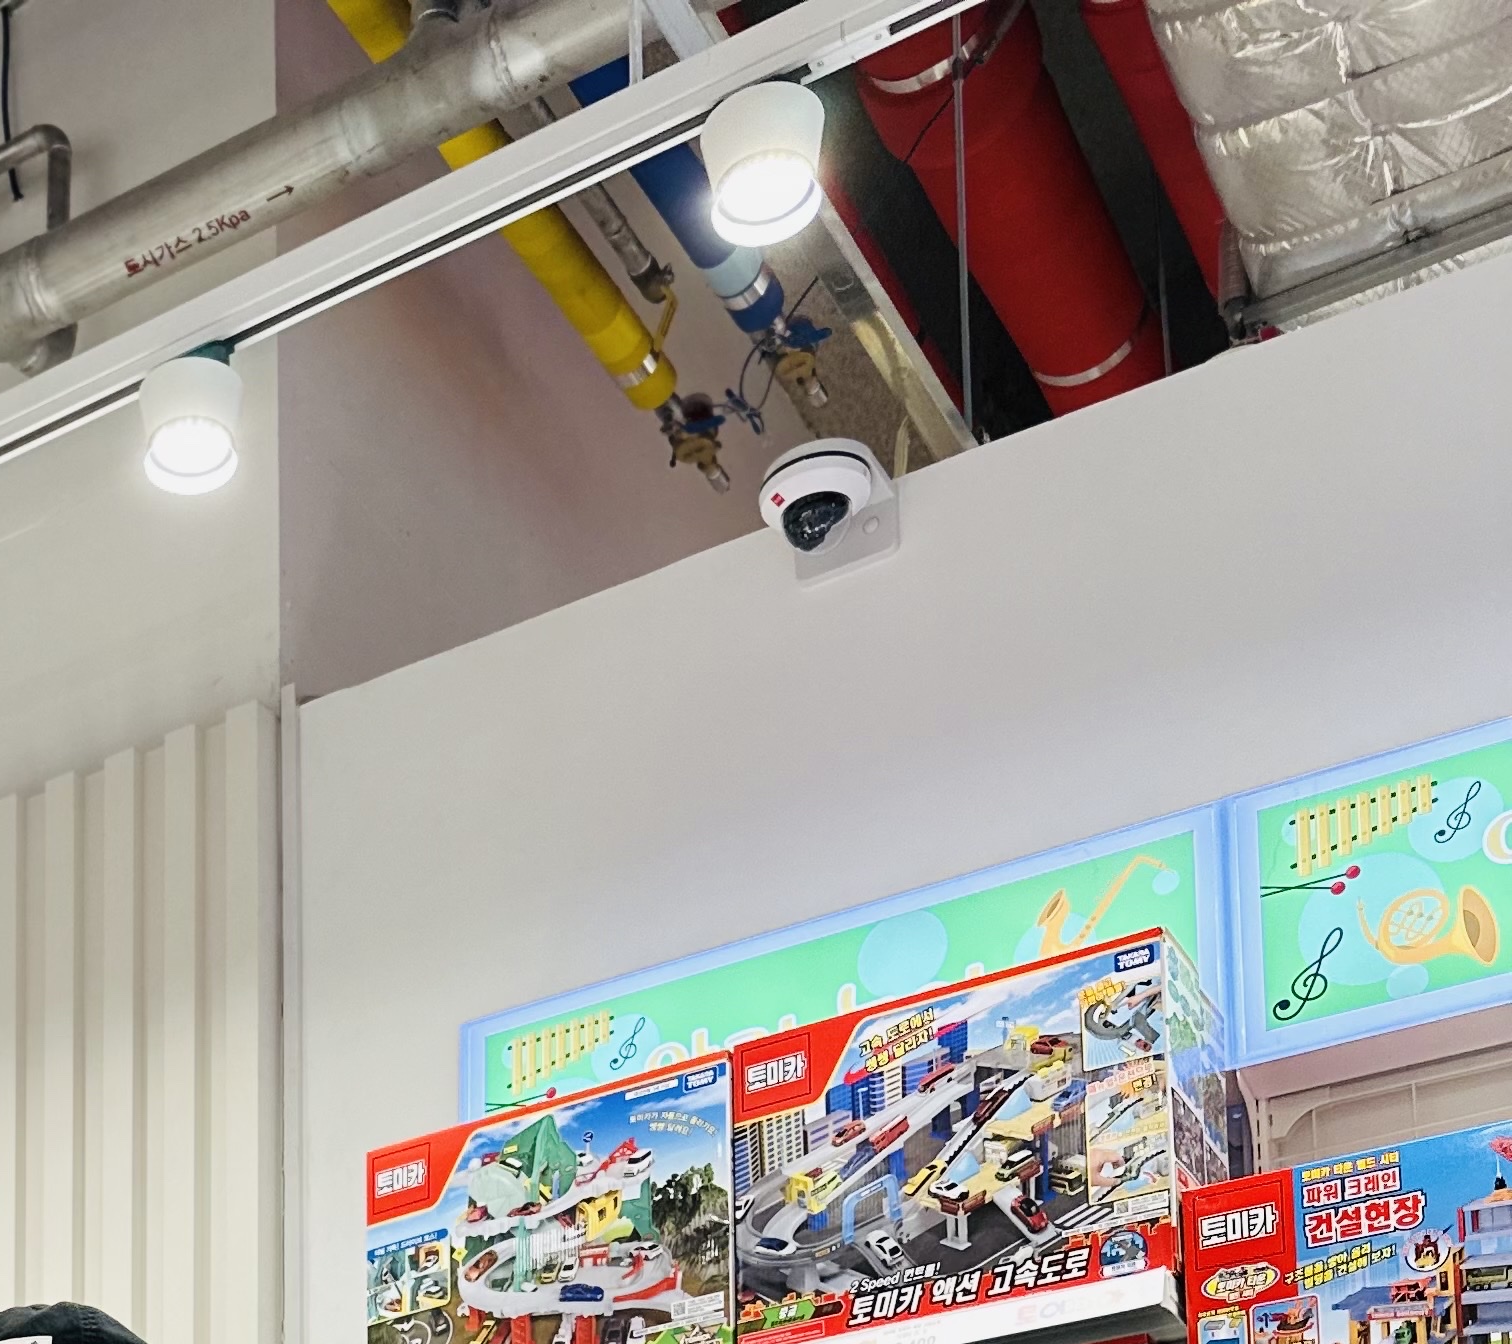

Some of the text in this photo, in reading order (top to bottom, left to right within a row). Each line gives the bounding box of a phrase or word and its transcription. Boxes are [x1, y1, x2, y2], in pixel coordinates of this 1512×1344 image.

[124, 206, 251, 278] 도시가스 2.5Kpa
[1117, 948, 1150, 962] TAKARA
[1118, 955, 1150, 969] TOMY
[745, 1056, 807, 1095] 토미카
[376, 1161, 426, 1197] 토미카
[1306, 1170, 1397, 1204] 파워 크레인
[1200, 1205, 1276, 1247] 토미카
[1307, 1194, 1423, 1245] 건설현장
[848, 1247, 1090, 1327] 토미카 액션 고속도로
[860, 1270, 901, 1292] Speed
